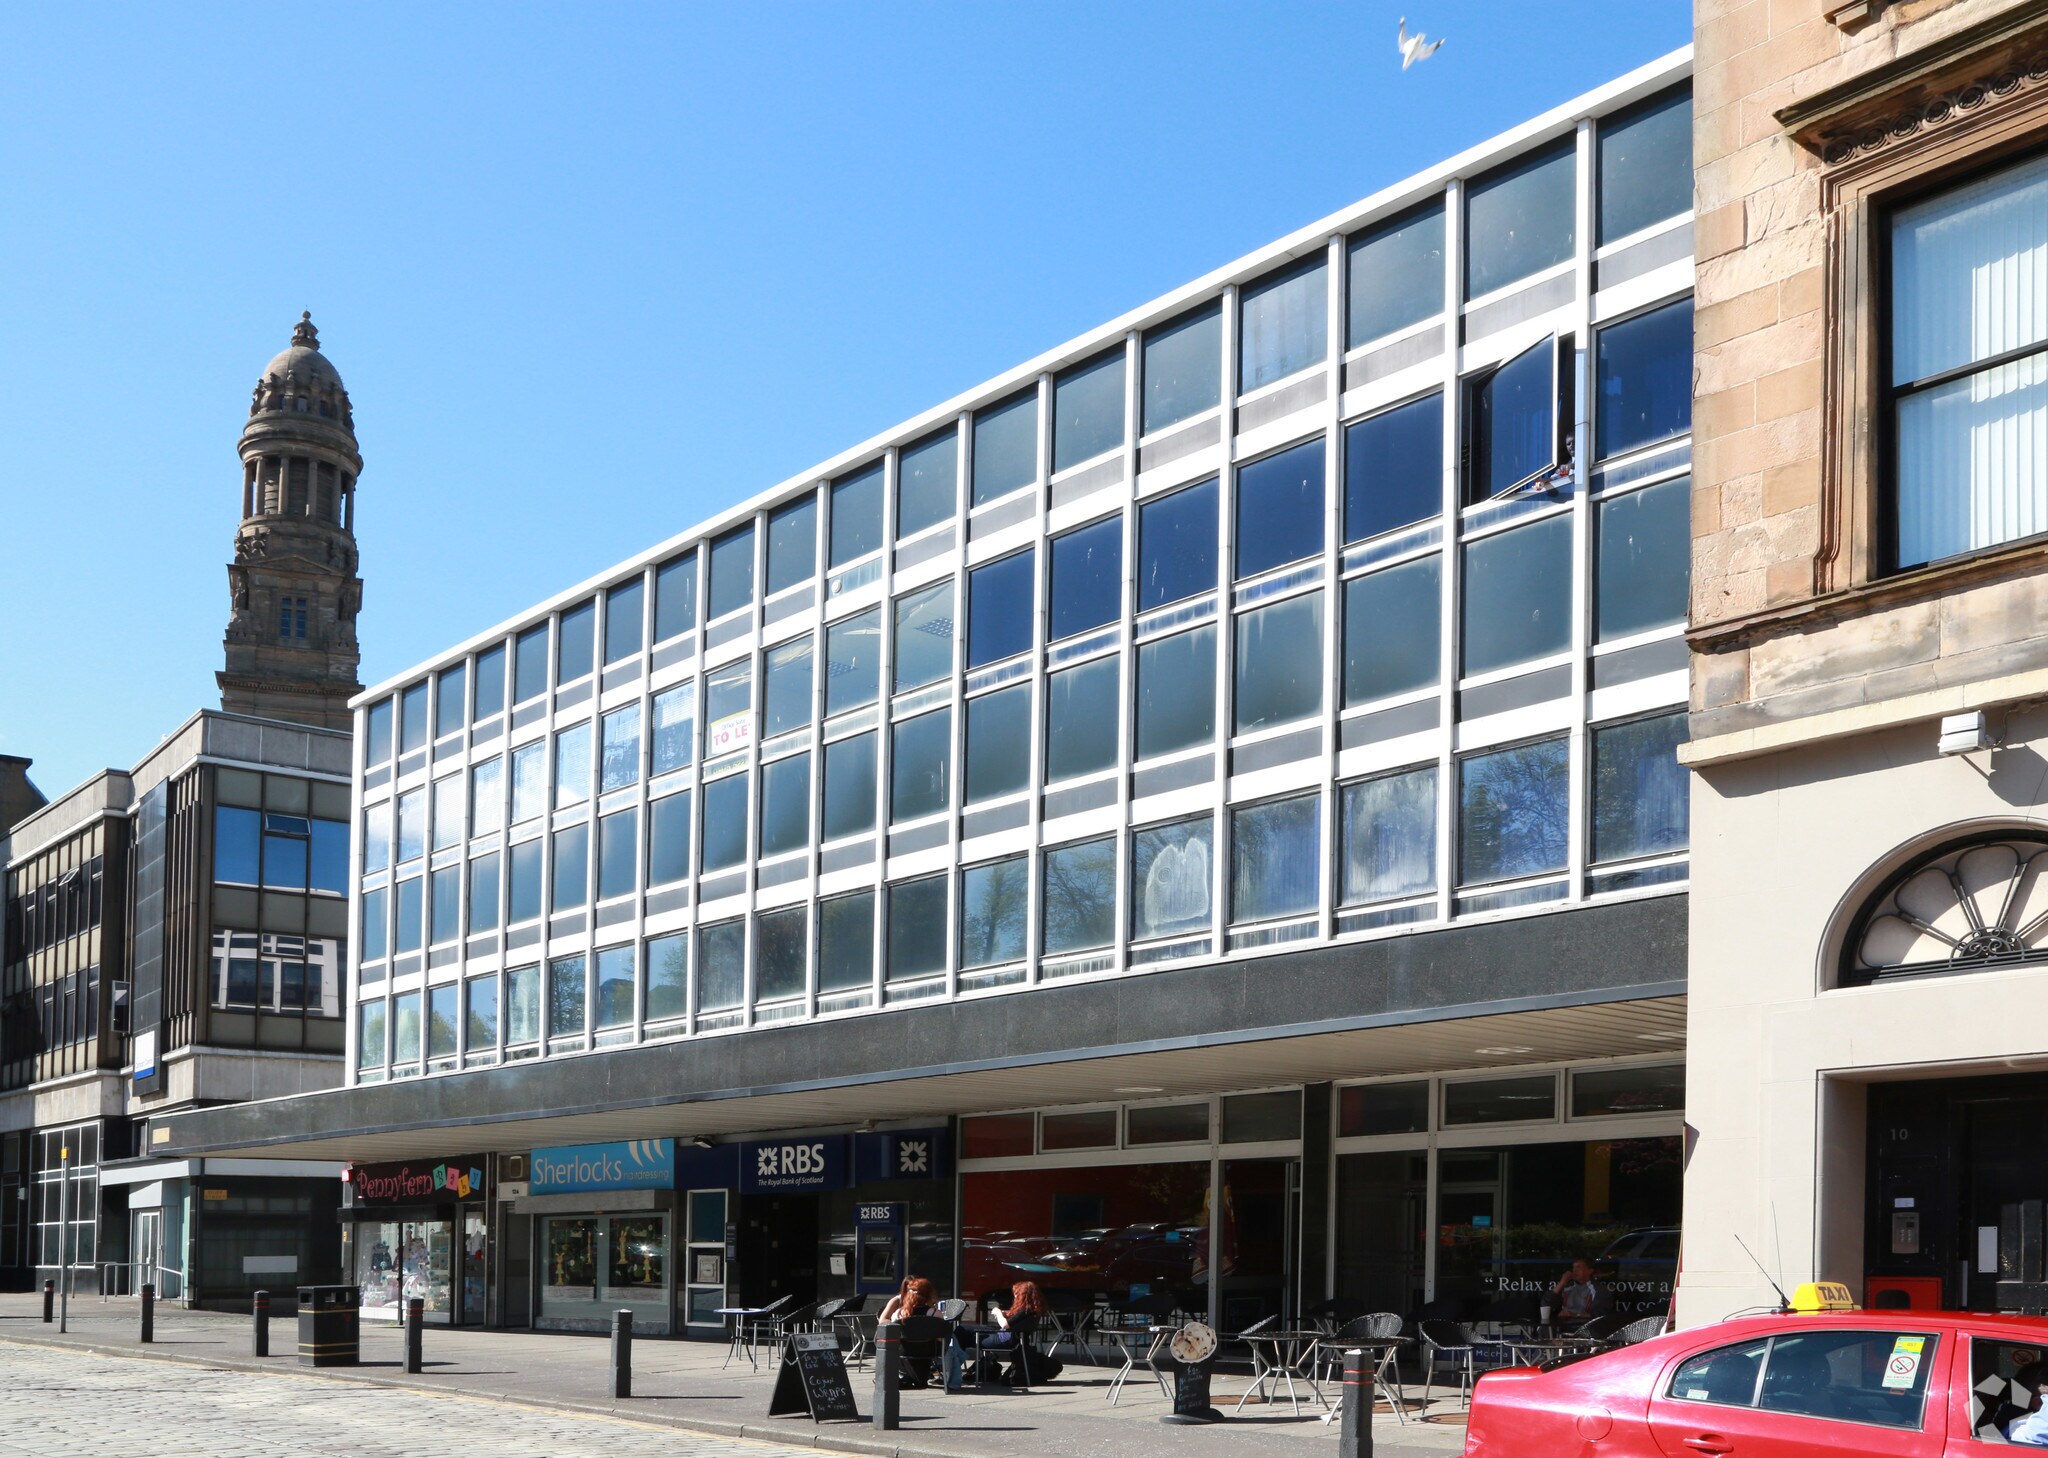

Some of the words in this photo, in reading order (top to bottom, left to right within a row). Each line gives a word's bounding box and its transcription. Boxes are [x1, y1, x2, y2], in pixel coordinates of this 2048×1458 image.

[713, 731, 730, 746] TO
[735, 723, 751, 738] LE
[1889, 1127, 1909, 1141] 10
[781, 1143, 825, 1175] RBS
[533, 1152, 623, 1185] Sherlocks
[356, 1167, 433, 1202] Pennyfern
[758, 1179, 768, 1187] The
[767, 1178, 782, 1188] Royal
[781, 1177, 795, 1186] Bank
[795, 1177, 801, 1187] of
[801, 1175, 825, 1186] Scotland
[870, 1206, 890, 1219] RBS
[1498, 1277, 1543, 1292] Relax
[1817, 1285, 1851, 1302] TAXI
